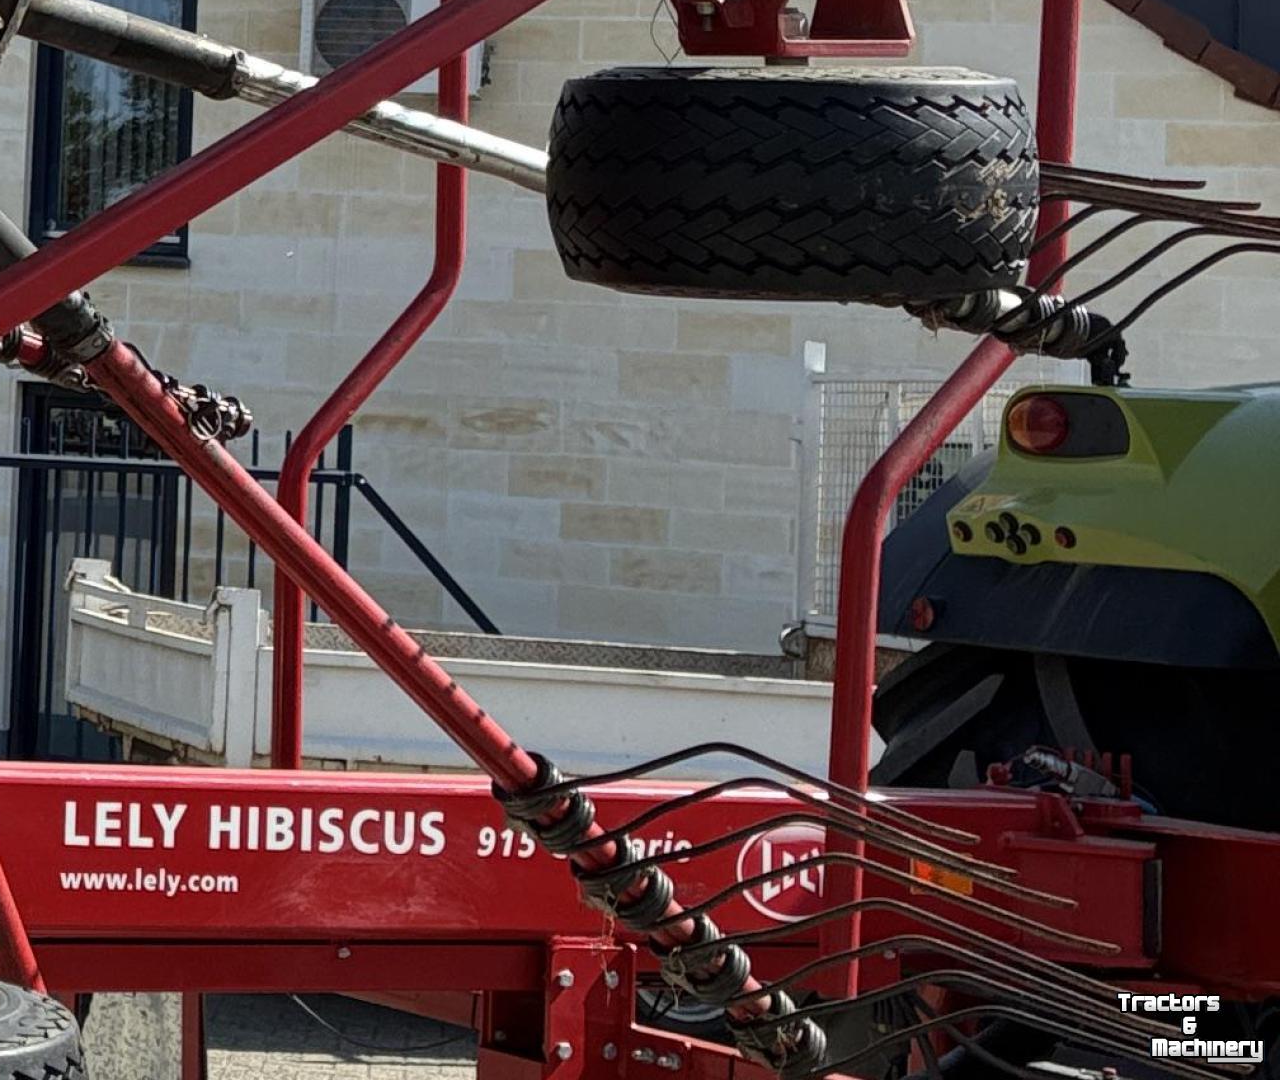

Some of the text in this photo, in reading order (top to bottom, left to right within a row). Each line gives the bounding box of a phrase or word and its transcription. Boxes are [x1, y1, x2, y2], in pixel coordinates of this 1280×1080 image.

[63, 800, 188, 849] LELY
[208, 804, 446, 857] HIBISCUS
[477, 825, 537, 859] 915
[59, 867, 239, 897] www.lely.com
